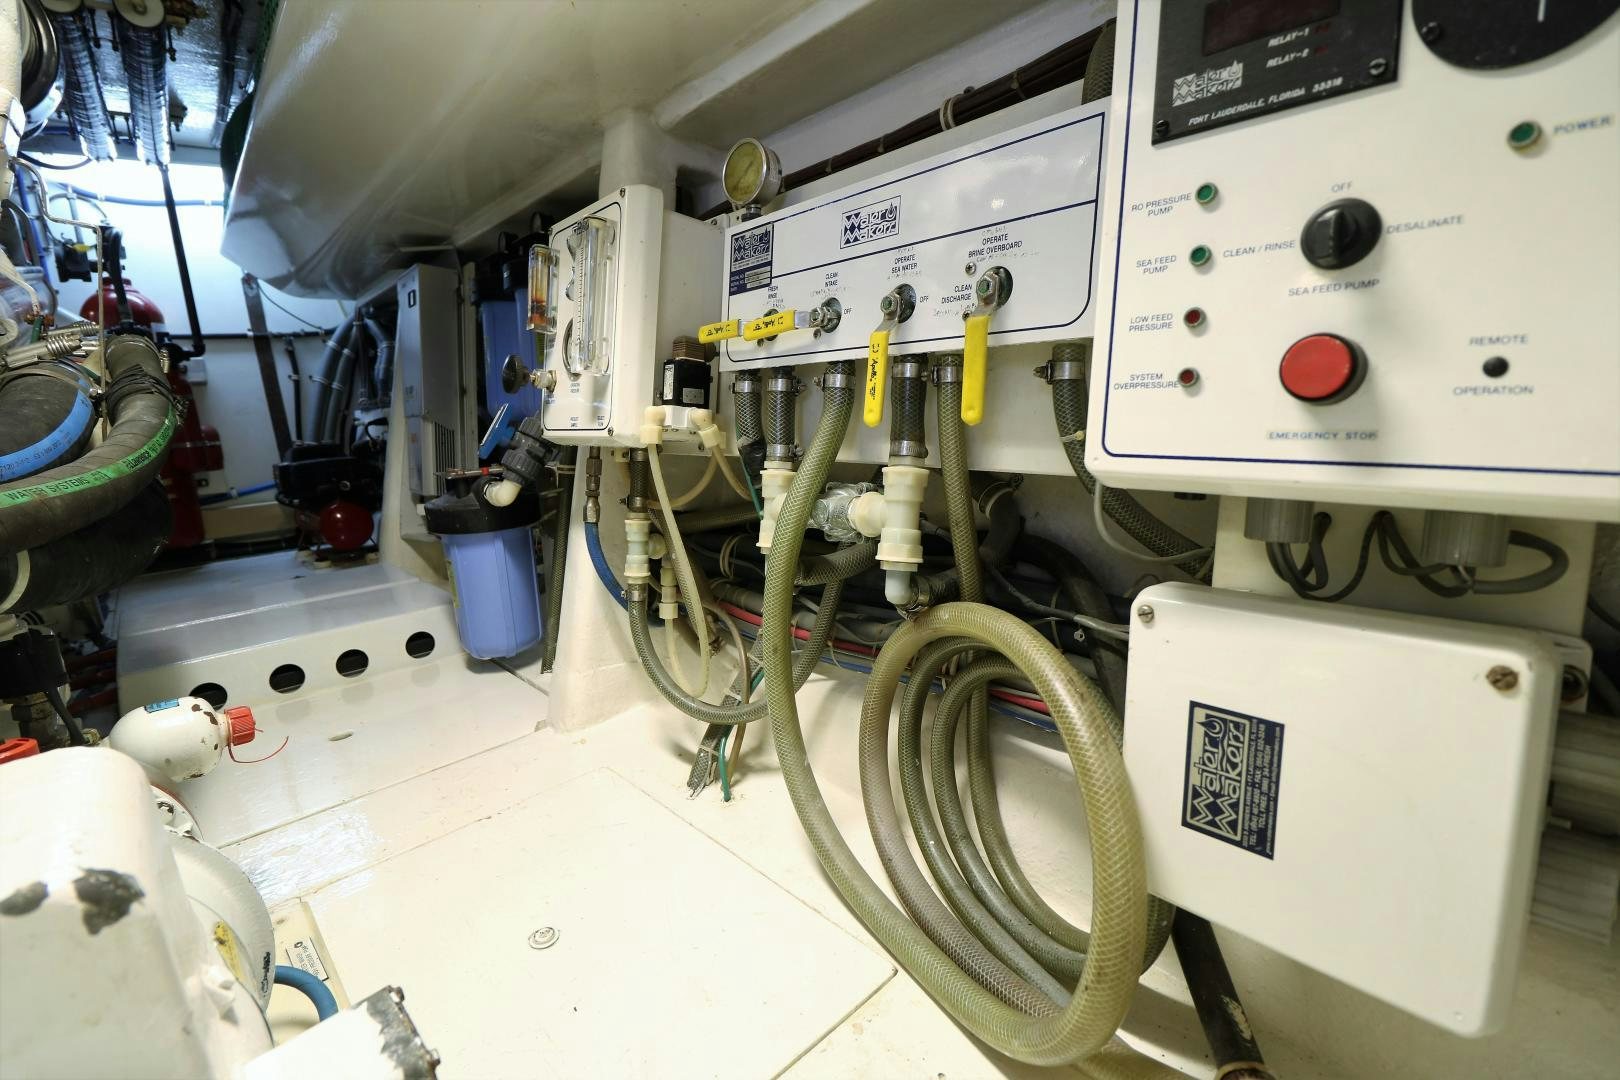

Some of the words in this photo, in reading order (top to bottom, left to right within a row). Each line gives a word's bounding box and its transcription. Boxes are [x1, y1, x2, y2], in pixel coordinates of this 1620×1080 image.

[1268, 28, 1310, 48] RELAY-1
[1266, 49, 1310, 68] RELAY-2
[1268, 87, 1306, 104] FLORIDA
[1553, 115, 1612, 134] POWER
[1331, 182, 1352, 192] OFF
[1132, 203, 1143, 212] RO
[1146, 192, 1192, 208] PRESSURE
[1148, 206, 1173, 216] PUMP
[1386, 214, 1464, 235] DESALINATE
[982, 234, 1008, 246] OPERATE
[968, 248, 984, 258] BRINE
[986, 241, 1022, 254] OVERBOARD
[1223, 246, 1256, 258] CLEAN
[1264, 240, 1296, 252] RINSE
[894, 254, 916, 264] OPERATE
[1136, 260, 1152, 268] SEA
[1154, 255, 1176, 264] FEED
[892, 266, 900, 274] SEA
[902, 263, 918, 272] WATER
[1143, 266, 1168, 275] PUMP
[826, 272, 838, 280] CLEAN
[954, 284, 972, 292] CLEAN
[1288, 286, 1310, 297] SEA
[1312, 282, 1342, 294] FEED
[1344, 278, 1380, 290] PUMP
[942, 293, 972, 304] DISCHARGE
[1130, 316, 1149, 324] LOW
[1150, 313, 1173, 322] FEED
[1129, 322, 1173, 332] PRESSURE
[1468, 334, 1529, 346] REMOTE
[1114, 381, 1179, 390] OVERPRESSURE
[1452, 386, 1534, 396] OPERATION
[1268, 431, 1339, 441] EMERGENCY
[1345, 430, 1378, 440] STOP
[4, 488, 44, 501] WATER
[46, 477, 90, 493] SYSTEMS
